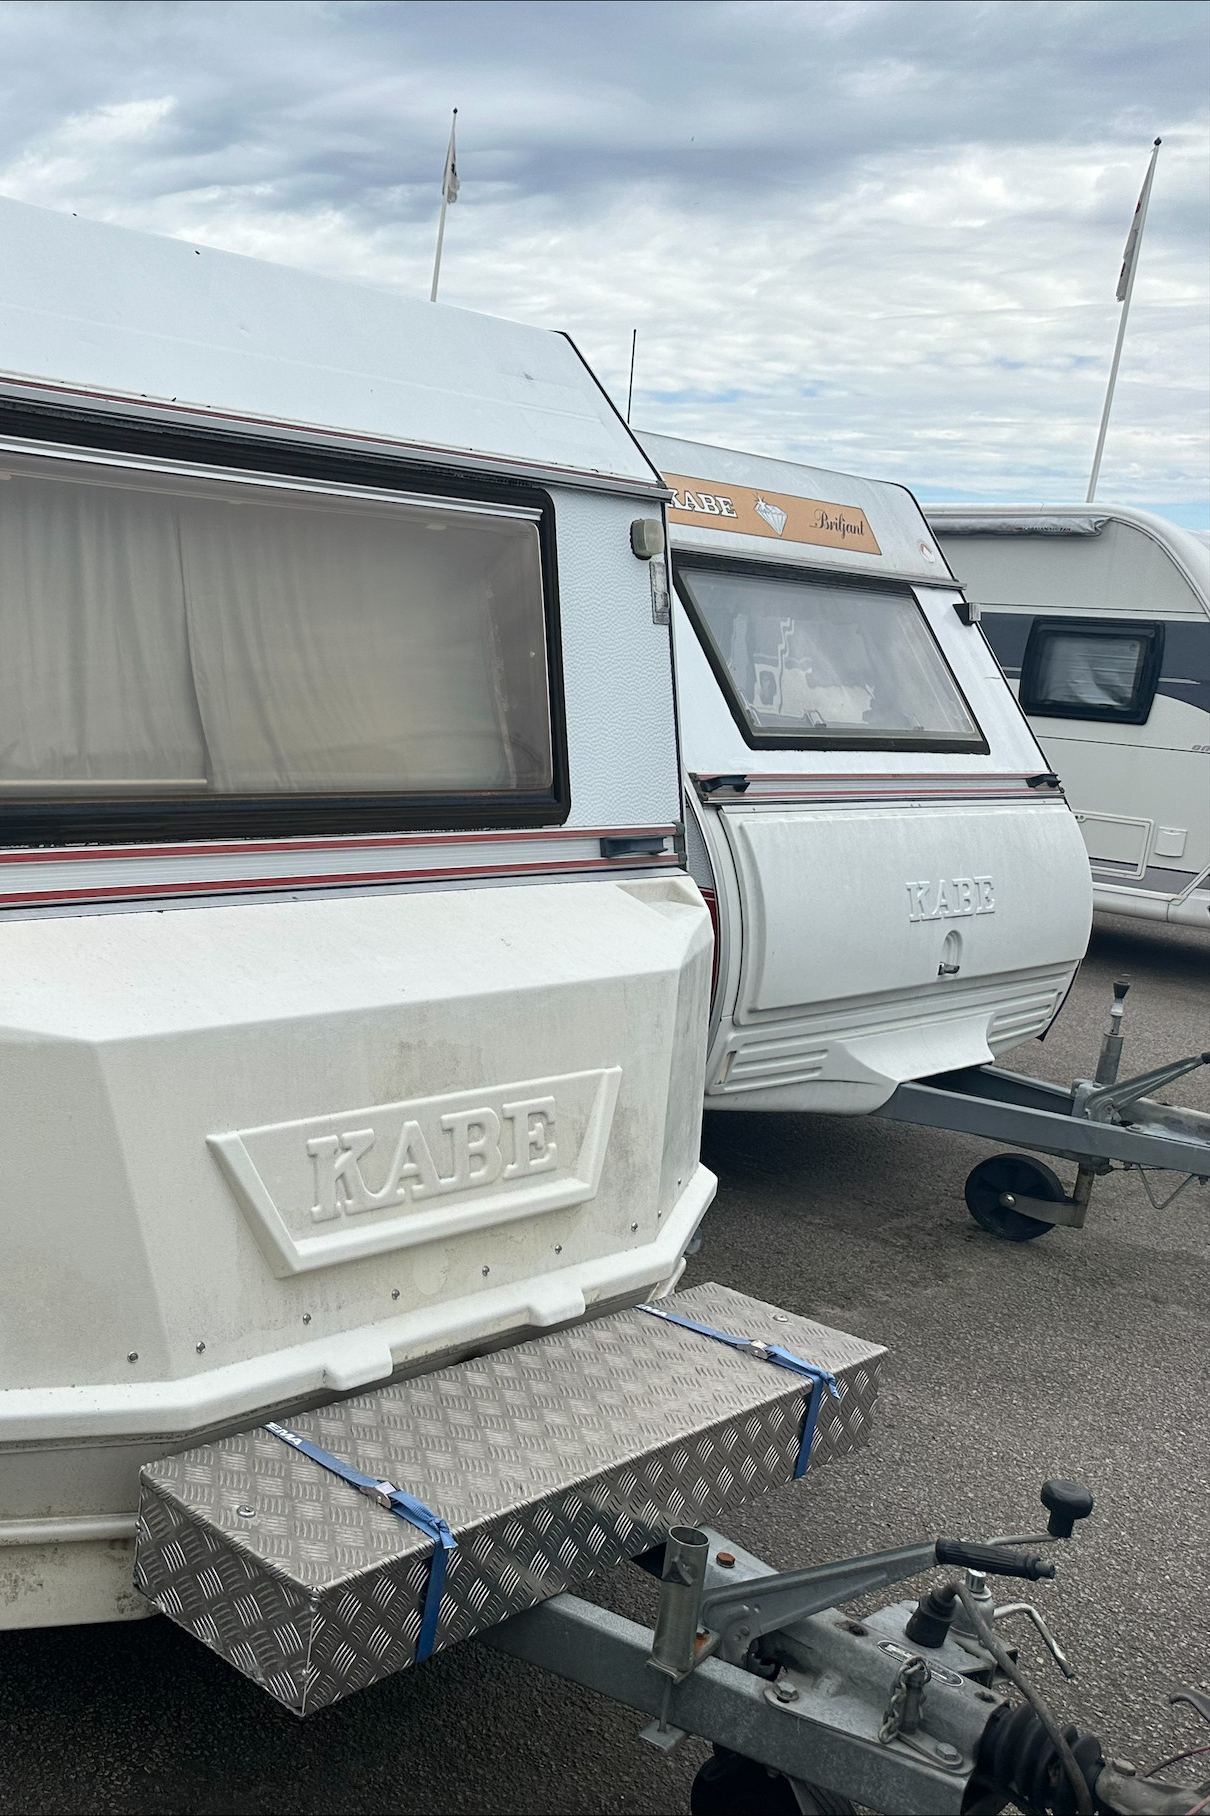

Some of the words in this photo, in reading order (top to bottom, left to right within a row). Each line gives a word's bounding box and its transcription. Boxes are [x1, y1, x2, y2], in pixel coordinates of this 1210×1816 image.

[809, 508, 865, 539] Briljant
[905, 875, 995, 922] KABE
[306, 1095, 558, 1223] KABE
